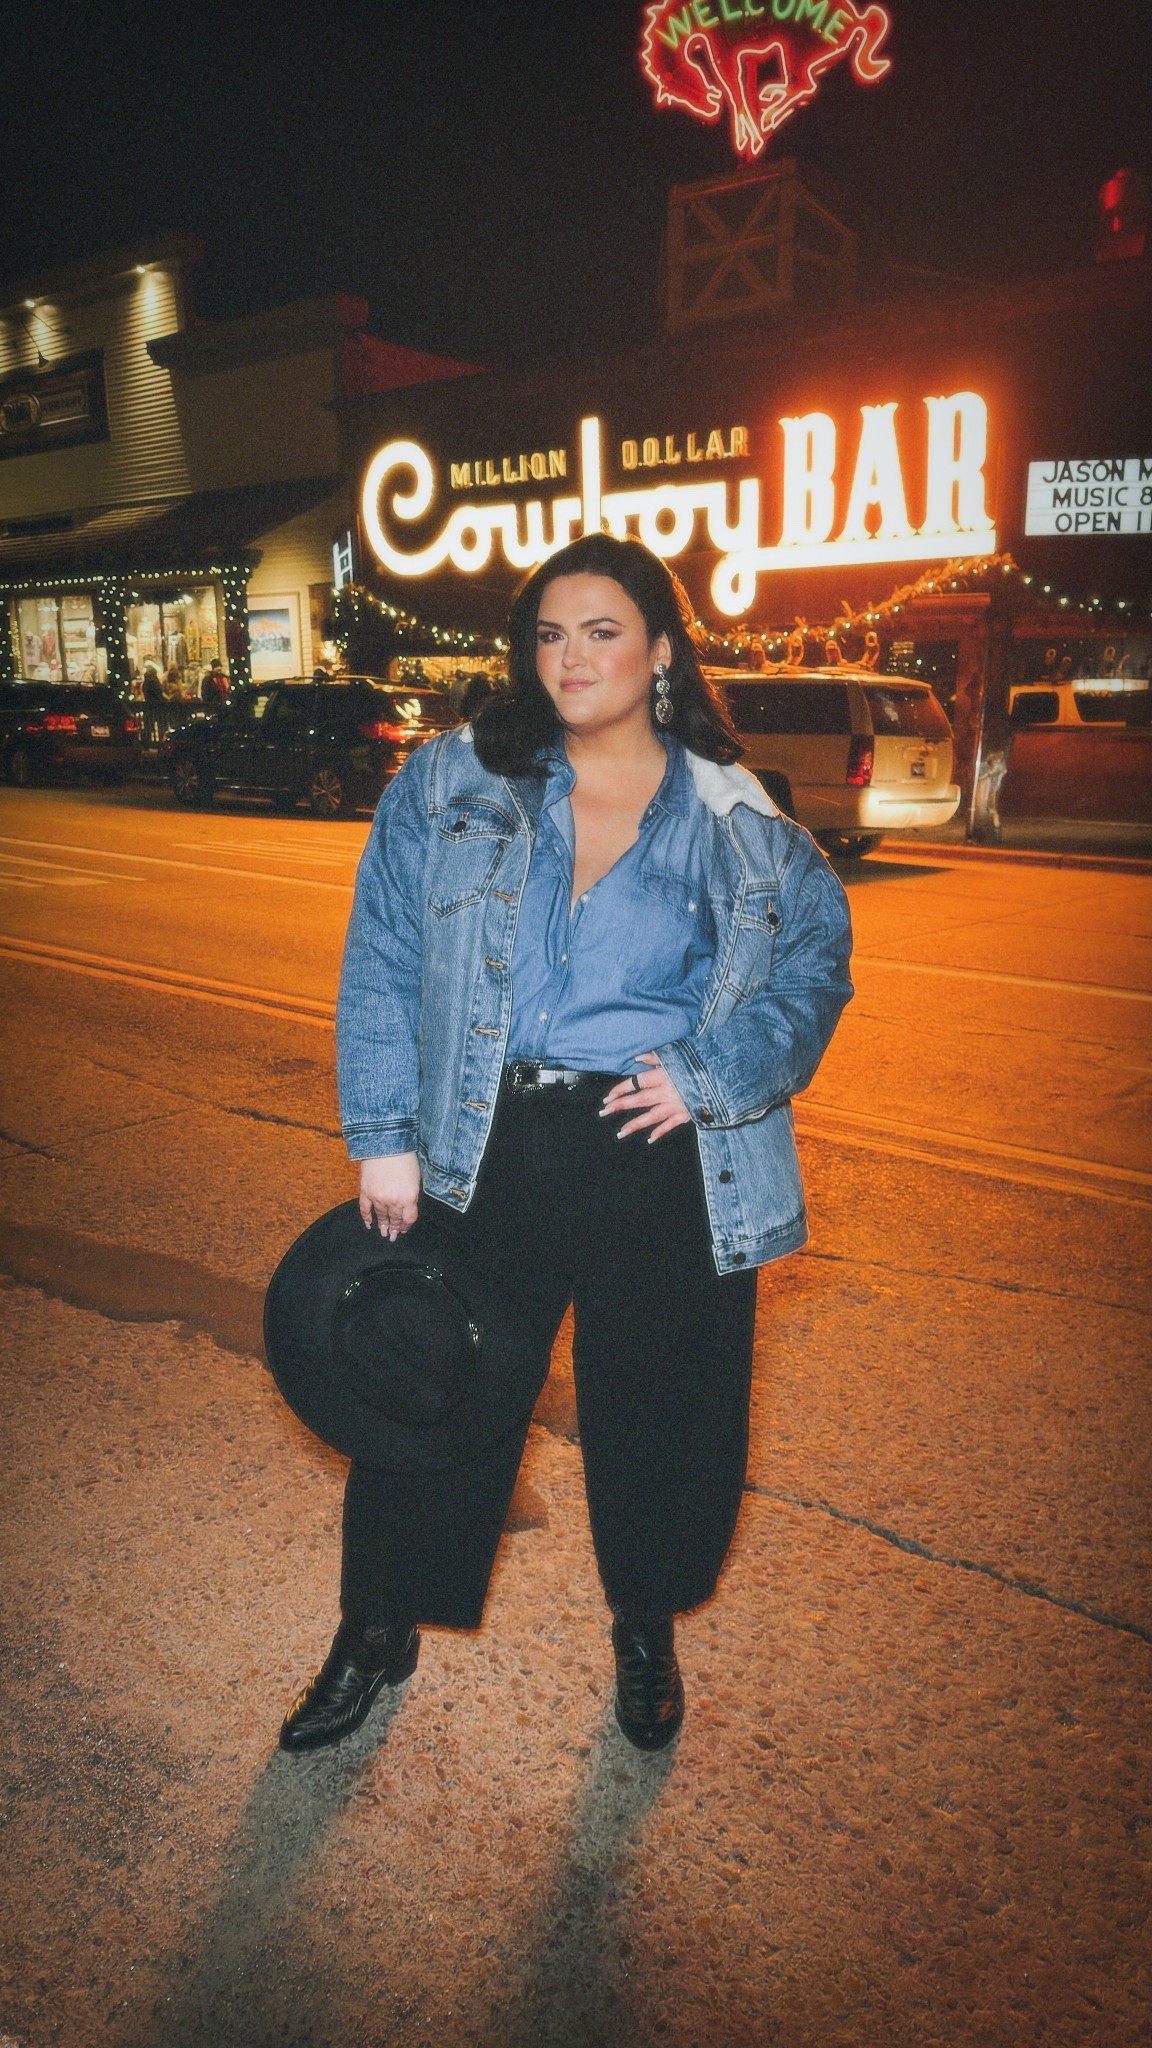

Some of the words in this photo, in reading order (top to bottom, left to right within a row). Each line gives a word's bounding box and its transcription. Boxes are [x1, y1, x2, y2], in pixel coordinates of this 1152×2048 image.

[654, 0, 854, 47] WELCOME
[450, 449, 567, 489] MILLION
[621, 425, 750, 470] DOLLAR
[1042, 460, 1125, 482] JASON
[362, 416, 762, 616] Cowboy
[779, 391, 996, 547] BAR
[1053, 487, 1128, 508] MUSIC
[1055, 511, 1121, 532] OPEN
